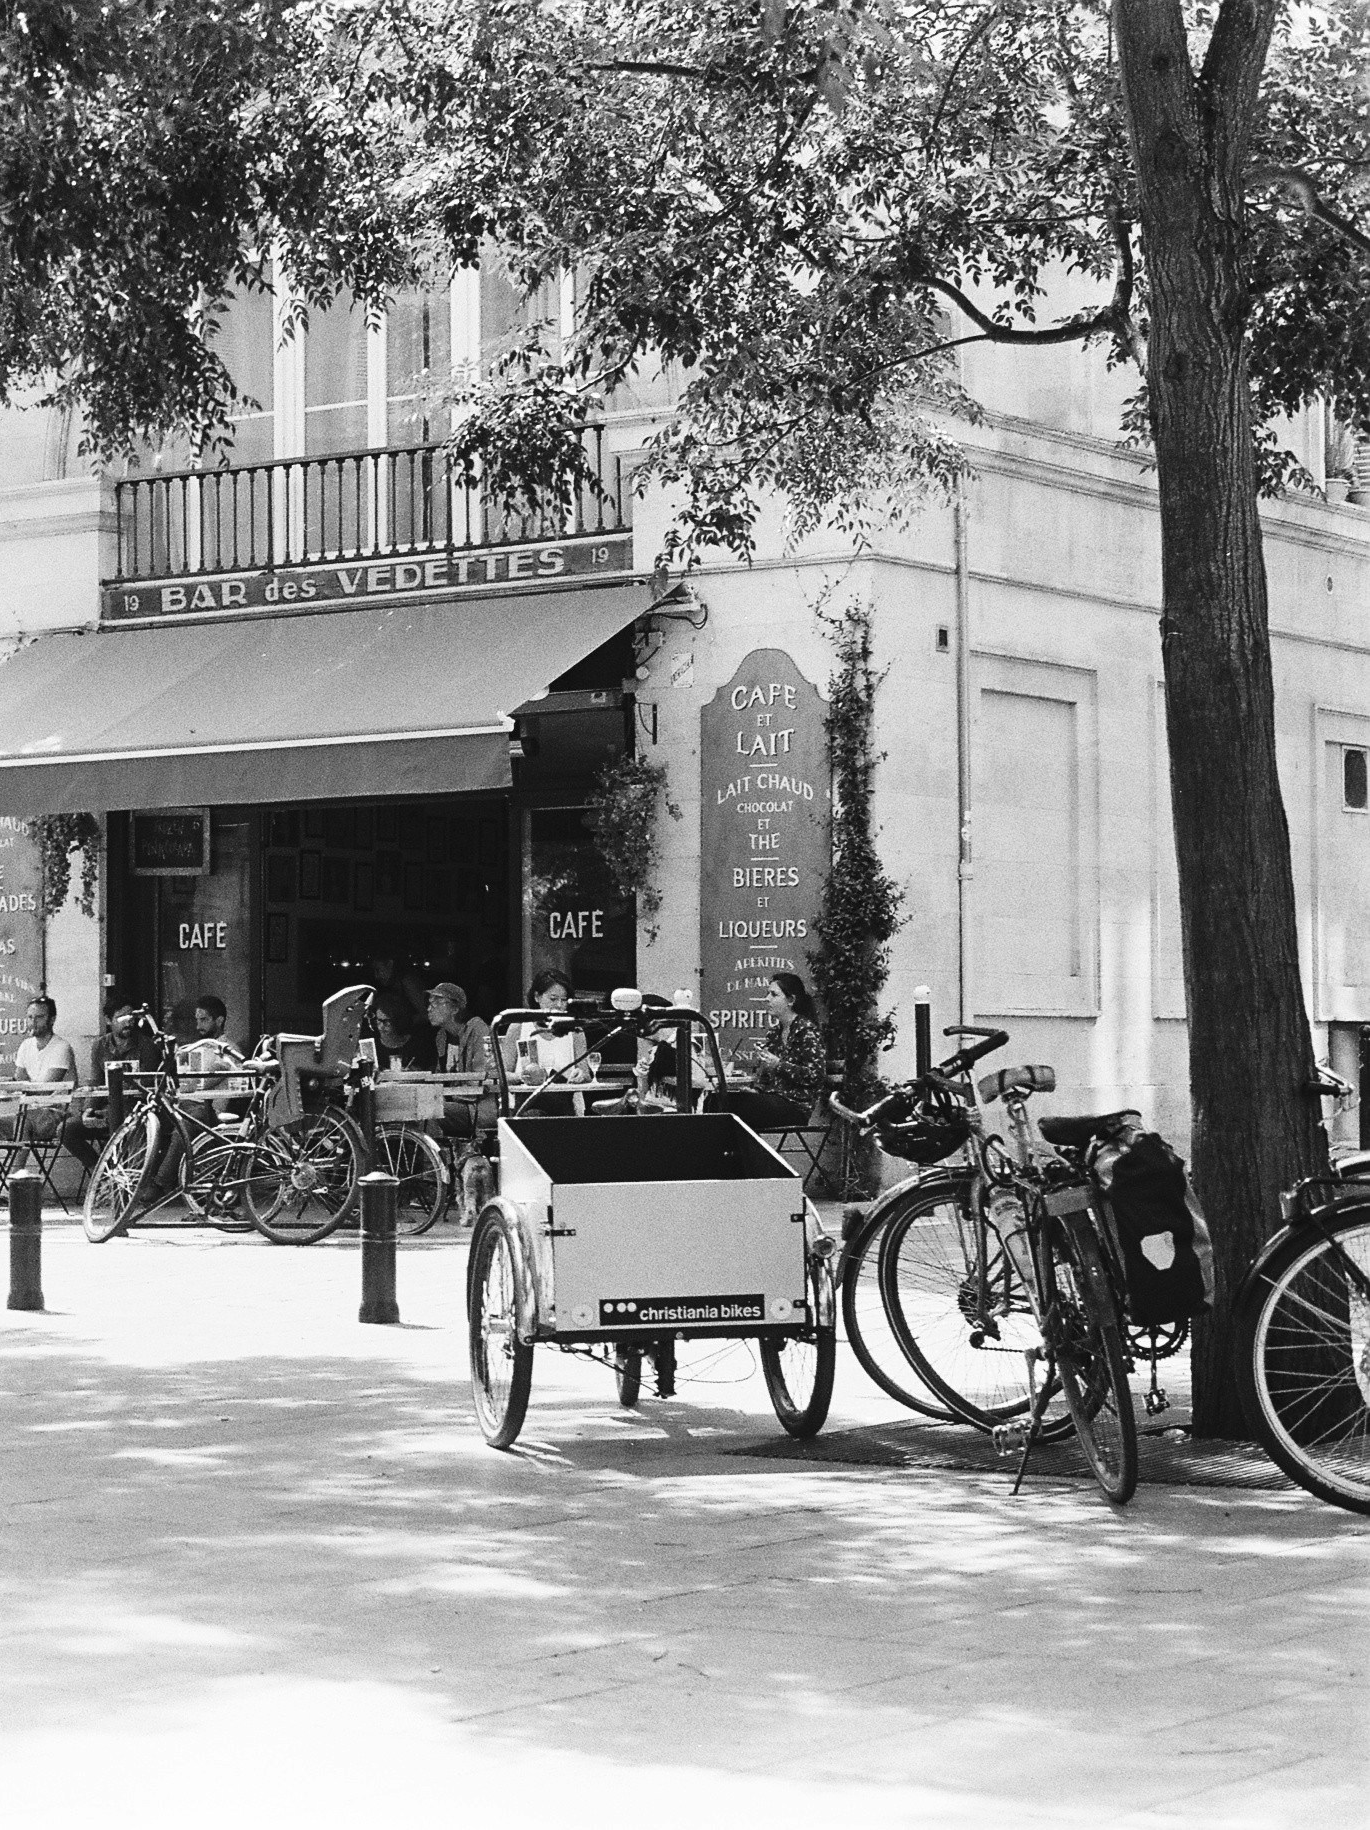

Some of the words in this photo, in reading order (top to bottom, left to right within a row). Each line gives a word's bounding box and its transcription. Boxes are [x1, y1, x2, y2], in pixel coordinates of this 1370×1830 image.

[124, 595, 140, 612] 19
[161, 580, 248, 613] BAR
[265, 577, 317, 602] des
[336, 548, 565, 594] VEDETTES
[591, 547, 609, 564] 19
[731, 683, 798, 711] CAFE
[757, 713, 772, 726] ET
[737, 728, 795, 756] LAIT
[717, 776, 751, 805] LAIT
[757, 773, 813, 800] CHAUD
[737, 800, 793, 813] CHOCOLAT
[757, 818, 770, 830] ET
[749, 833, 780, 850] THE
[733, 867, 800, 888] BIERES
[757, 896, 770, 908] ET
[719, 919, 808, 938] LIQUEURS
[709, 1010, 780, 1029] SPIRITU
[639, 1305, 719, 1321] christiania
[720, 1304, 762, 1318] bikes
